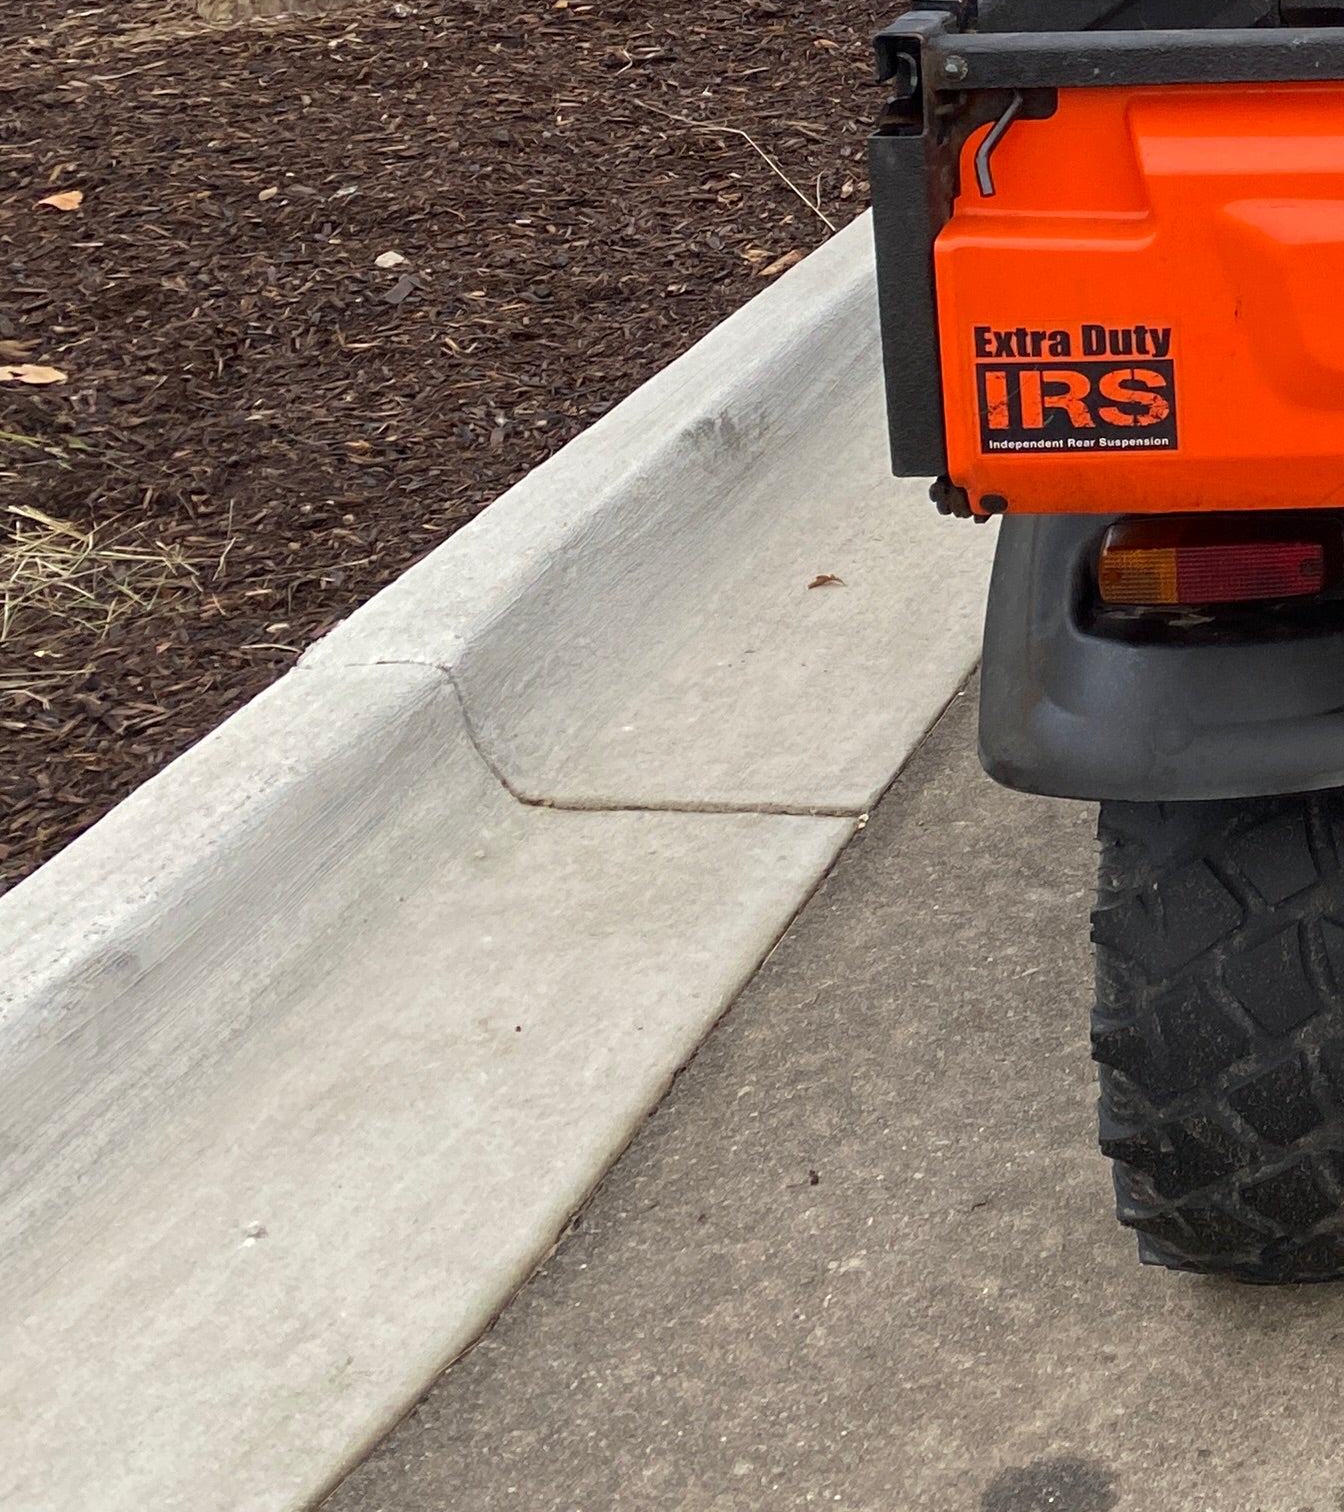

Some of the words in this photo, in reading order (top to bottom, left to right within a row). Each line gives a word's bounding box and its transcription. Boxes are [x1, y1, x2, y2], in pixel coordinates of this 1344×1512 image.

[974, 326, 1071, 358] Extra
[1082, 324, 1172, 359] Duty
[984, 368, 1171, 430] IRS
[989, 438, 1064, 451] Independent
[1068, 437, 1096, 449] Rear
[1099, 436, 1169, 451] Suspension
